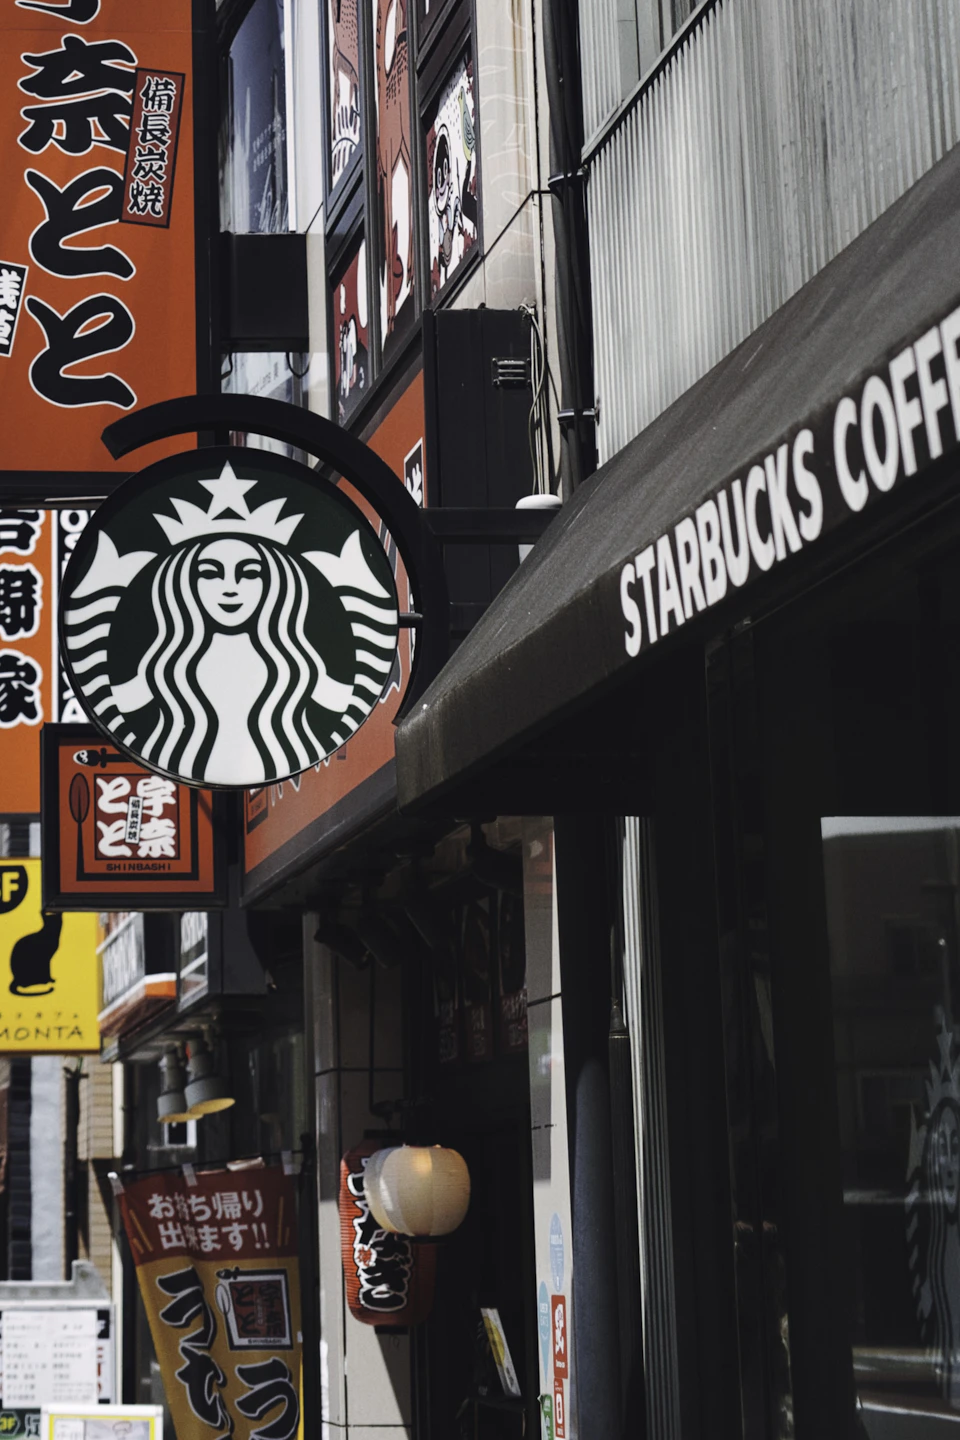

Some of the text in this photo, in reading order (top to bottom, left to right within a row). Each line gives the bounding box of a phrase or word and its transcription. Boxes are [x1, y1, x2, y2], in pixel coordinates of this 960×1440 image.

[128, 75, 175, 218] 備長炭焼
[620, 429, 823, 657] STARBUCKS
[106, 863, 171, 871] SHINBASHI
